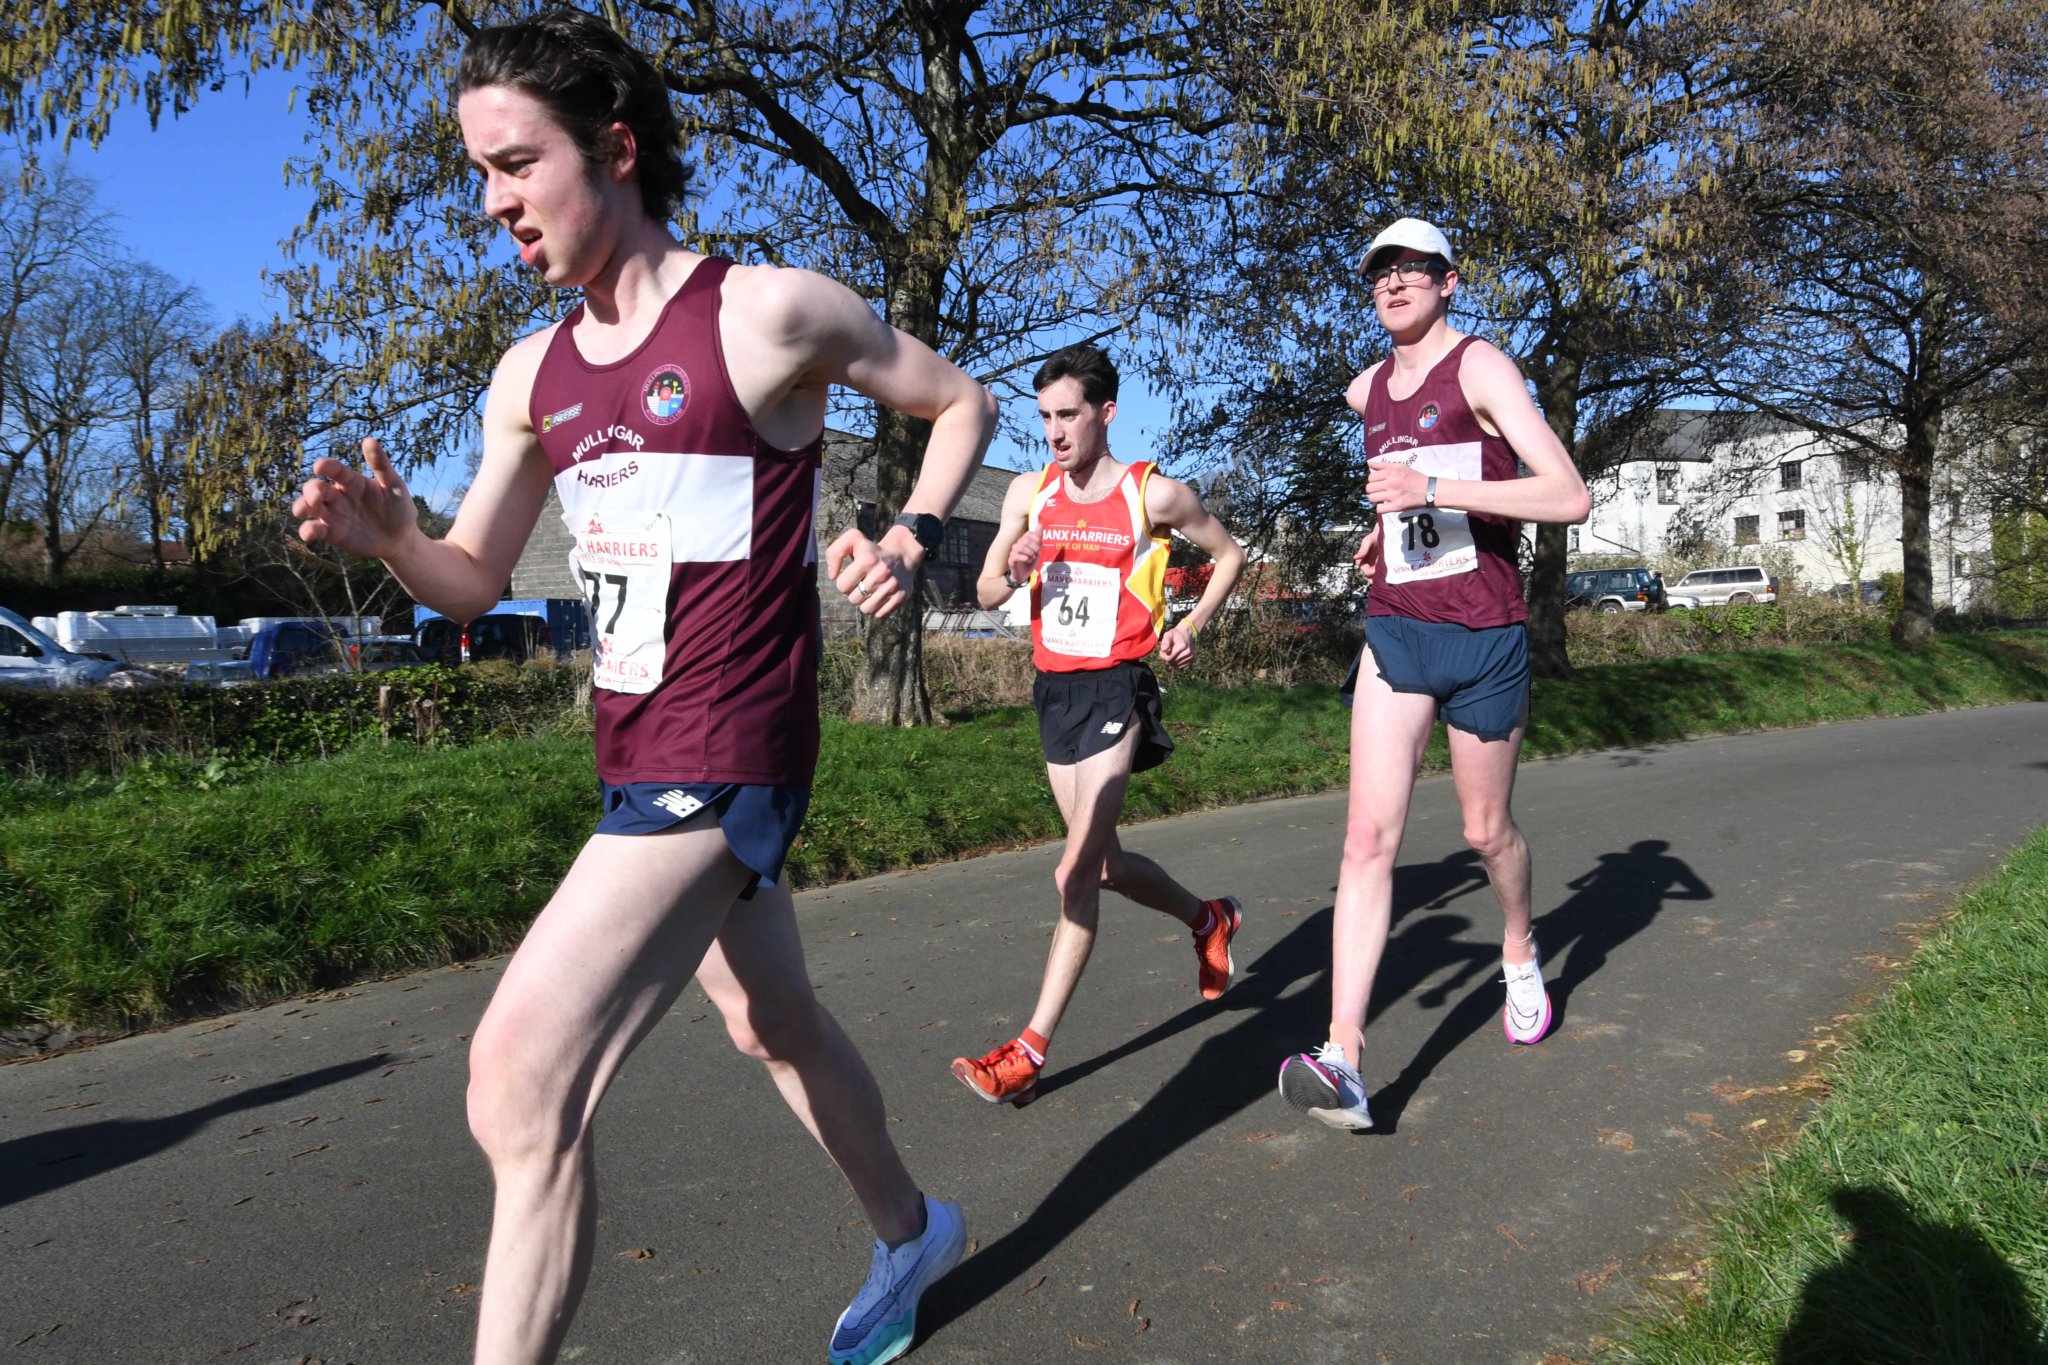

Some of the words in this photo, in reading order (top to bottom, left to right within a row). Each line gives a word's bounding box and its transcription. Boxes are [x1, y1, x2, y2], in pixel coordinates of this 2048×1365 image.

[1378, 434, 1419, 455] MULLINGAR
[1070, 530, 1130, 546] HARRIERS
[1400, 513, 1440, 551] 78
[586, 540, 658, 558] HARRIERS
[583, 570, 628, 635] 77
[1058, 594, 1090, 628] 64
